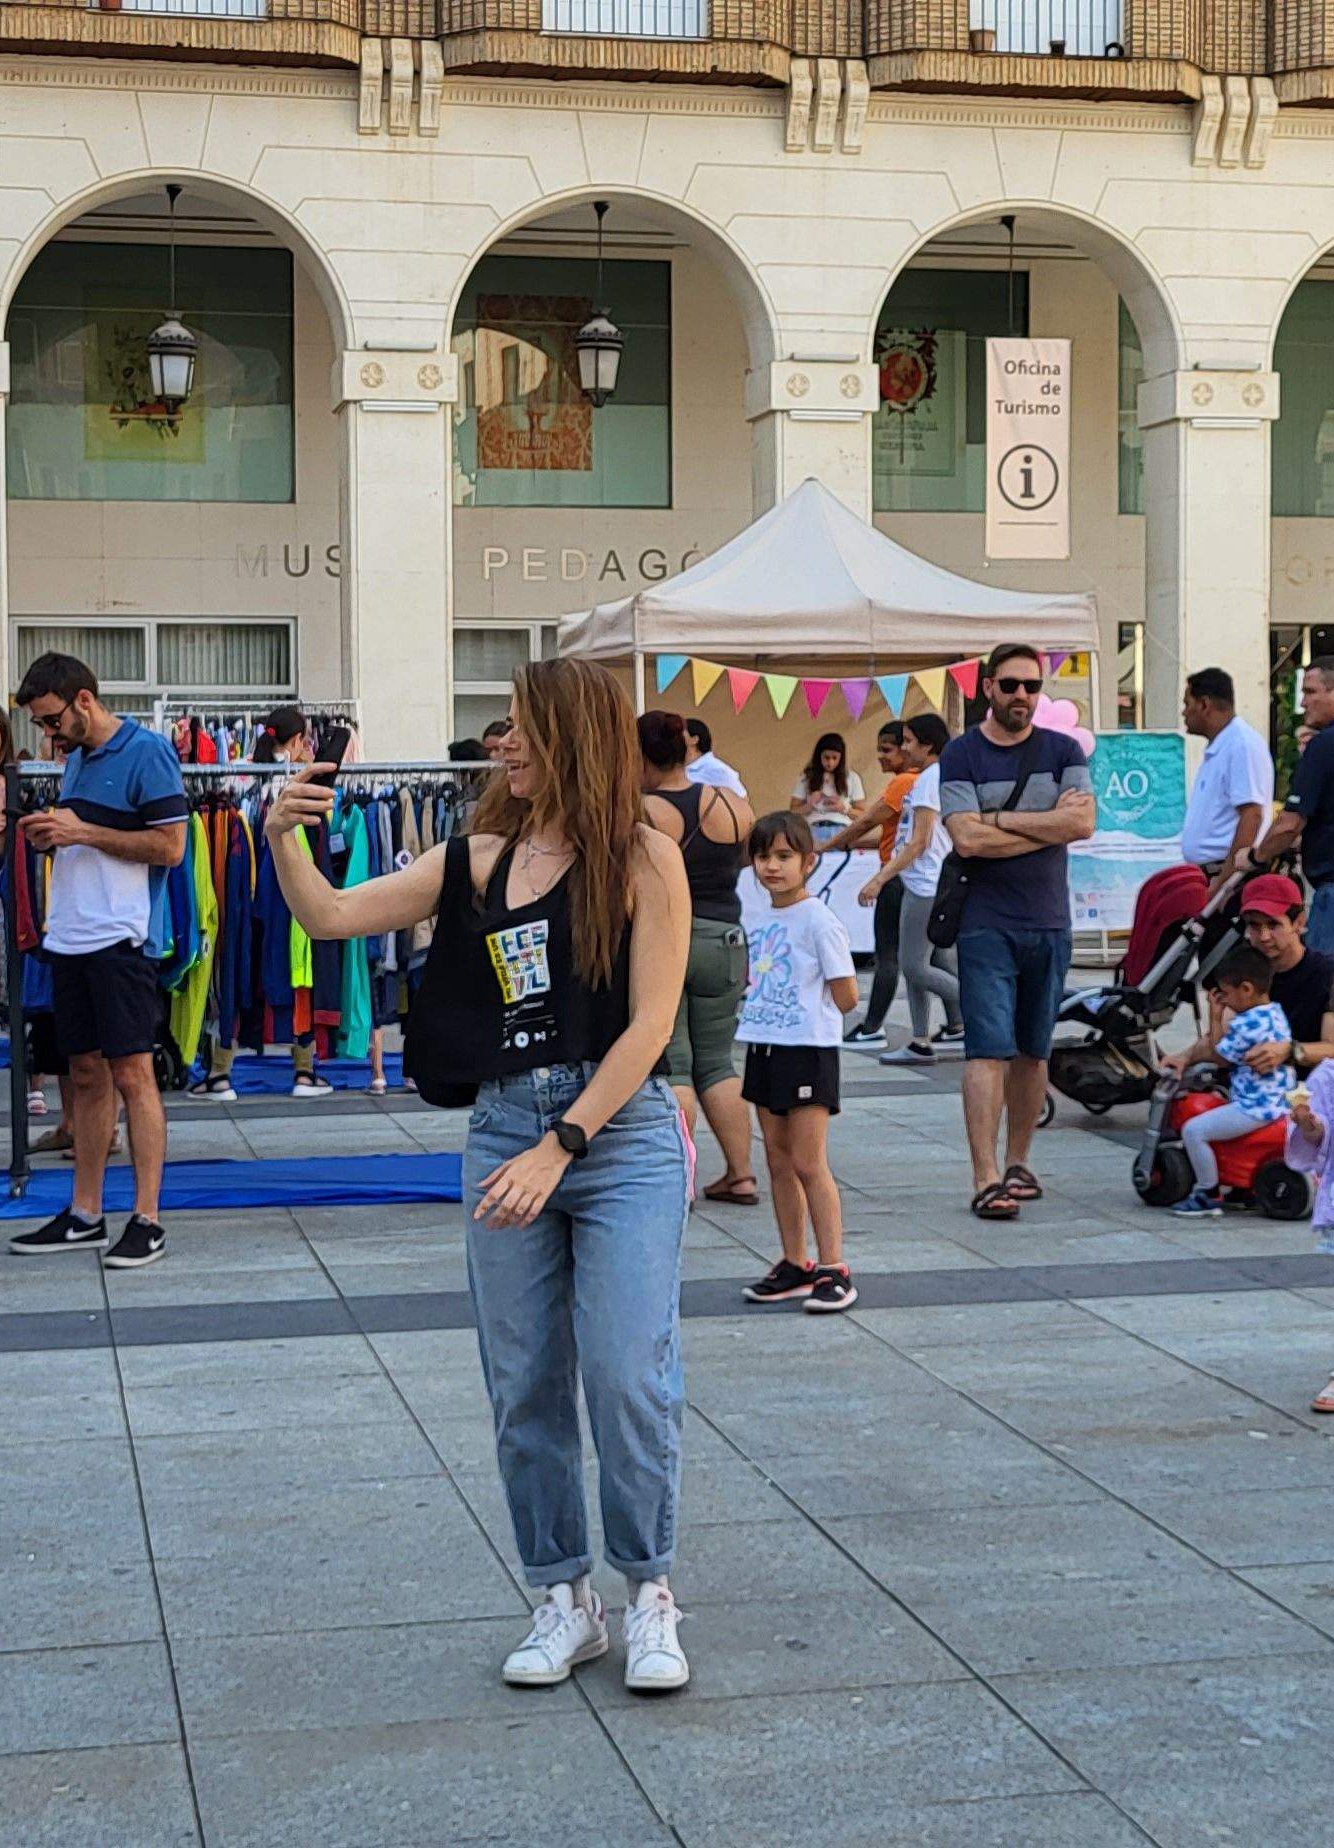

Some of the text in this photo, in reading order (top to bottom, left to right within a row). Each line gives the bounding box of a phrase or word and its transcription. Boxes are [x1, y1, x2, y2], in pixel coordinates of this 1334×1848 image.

[1004, 360, 1061, 376] Oficina
[1040, 380, 1062, 396] de
[995, 400, 1061, 415] Turismo
[235, 544, 341, 578] MUS
[1104, 770, 1149, 799] AO
